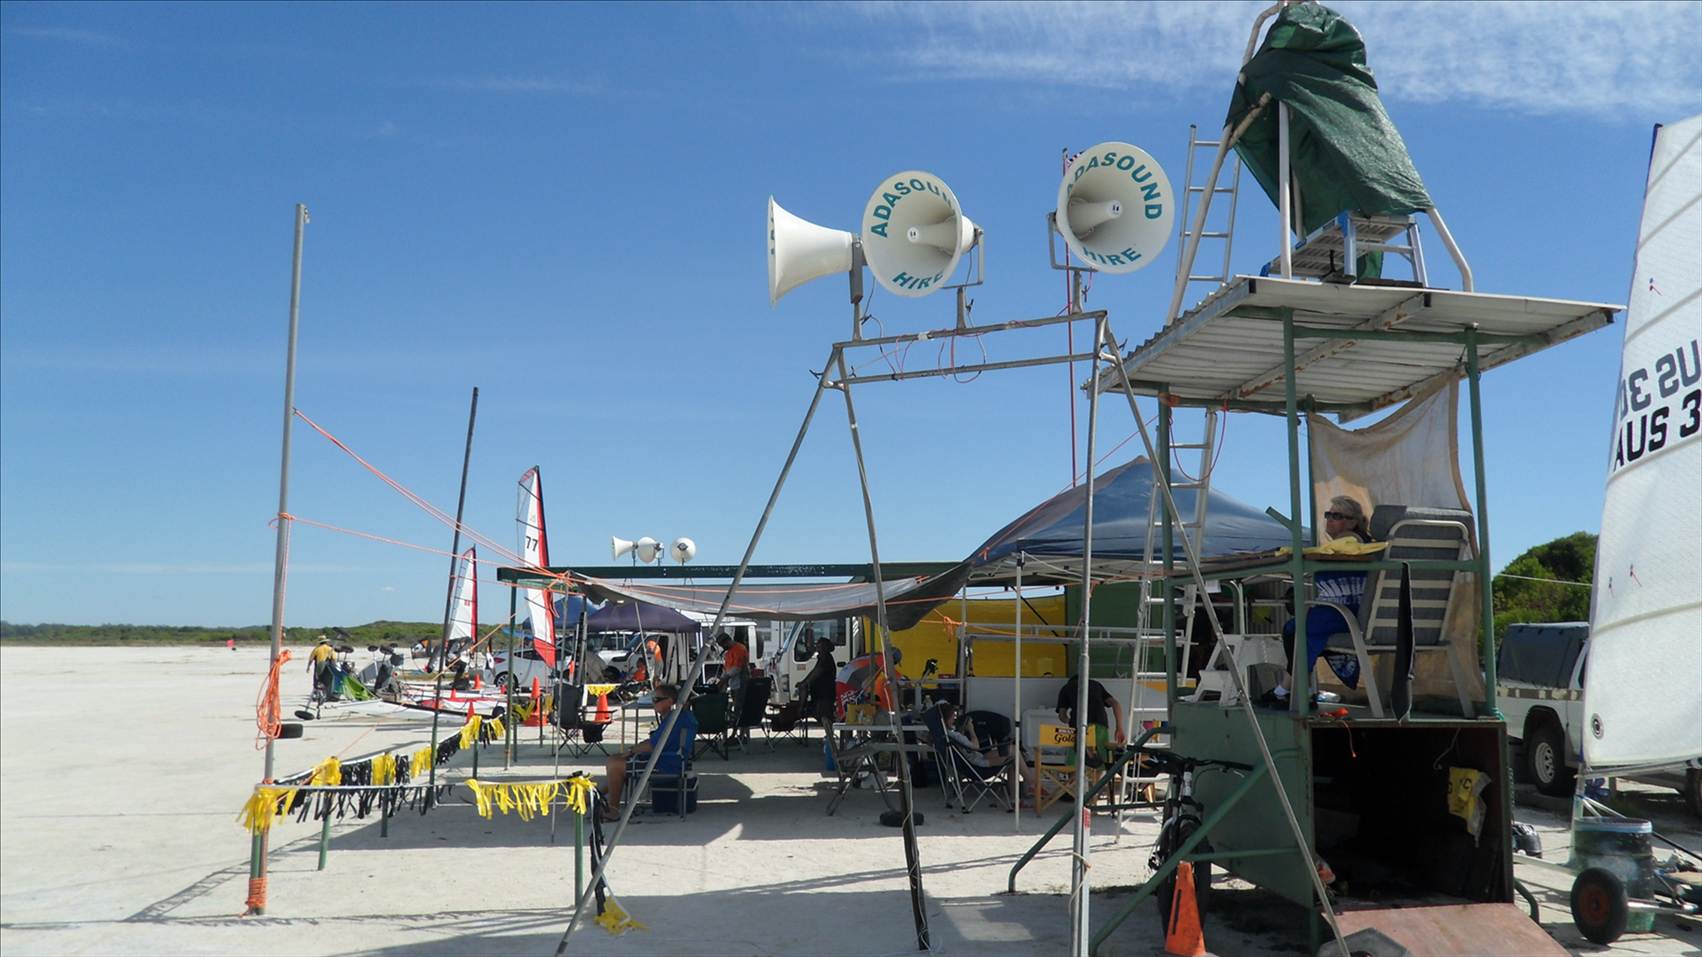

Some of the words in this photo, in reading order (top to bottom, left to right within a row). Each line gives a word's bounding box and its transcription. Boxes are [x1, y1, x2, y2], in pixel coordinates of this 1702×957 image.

[871, 178, 956, 238] ADASOU
[1066, 152, 1162, 219] ADASOUND
[1083, 247, 1142, 266] HIRE
[1613, 406, 1669, 472] AUS
[525, 535, 538, 552] 77
